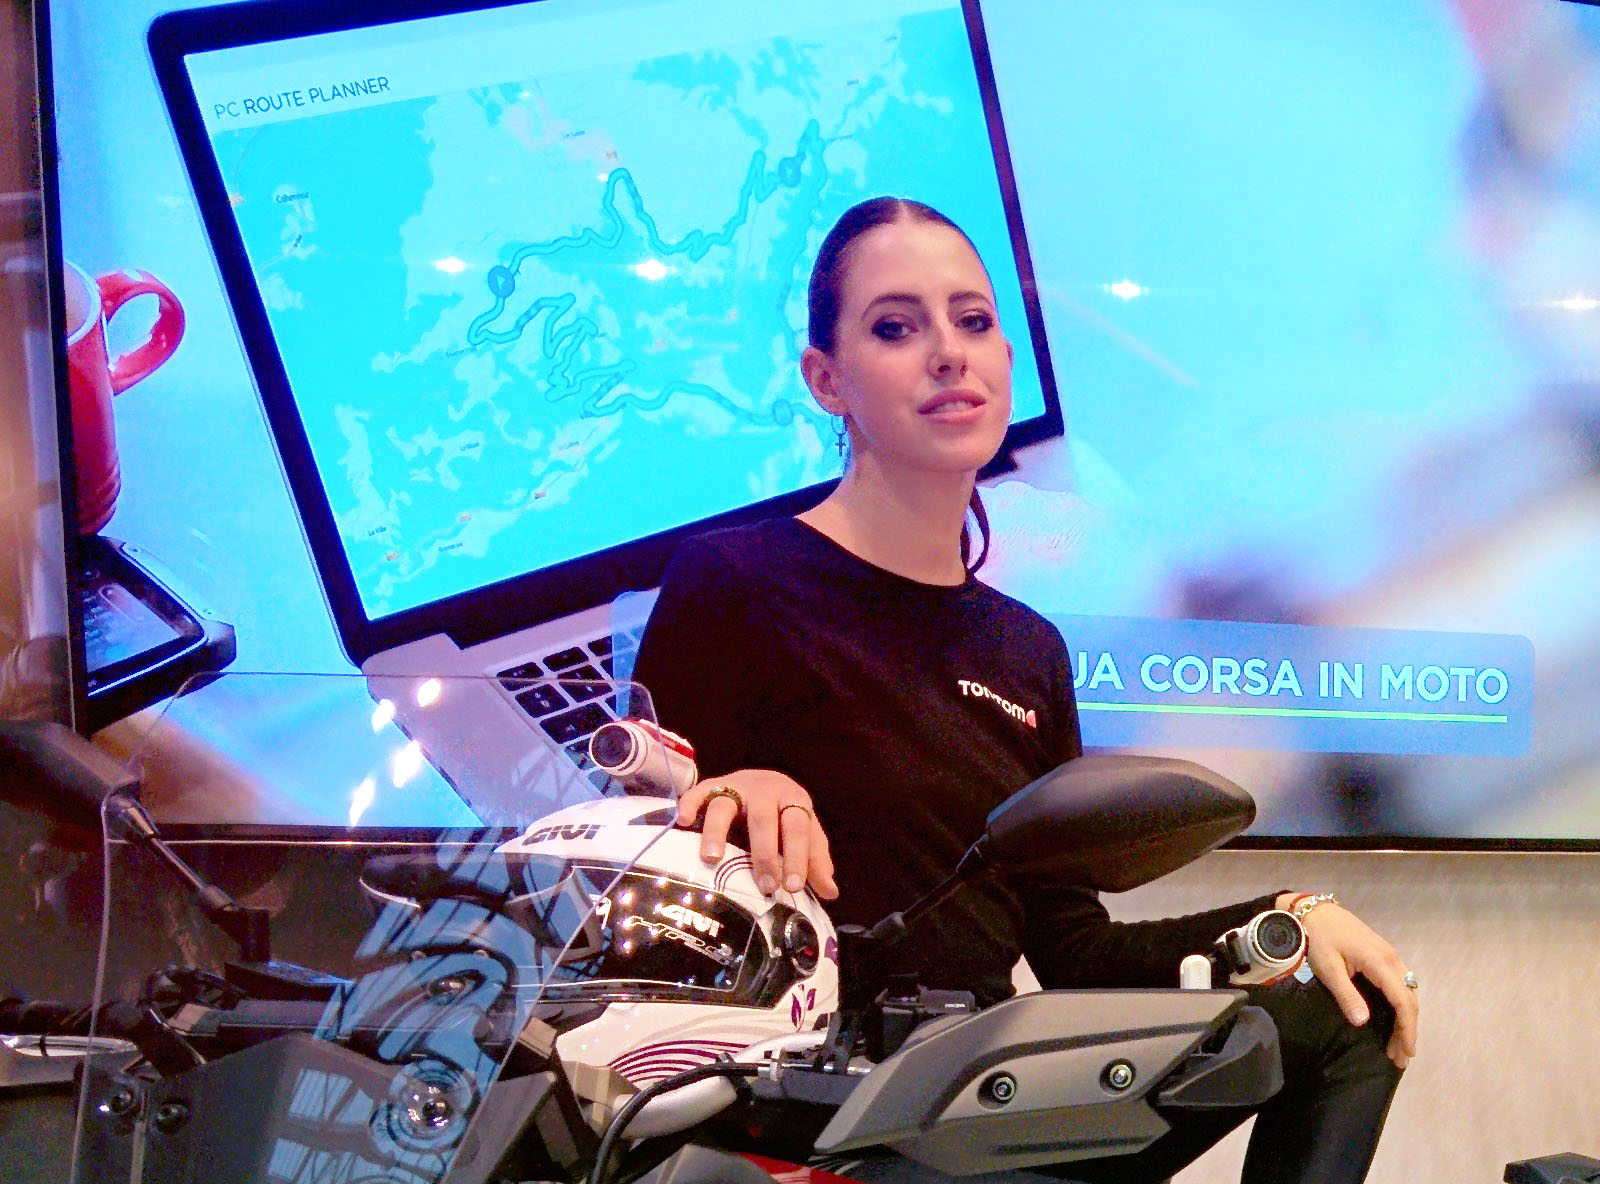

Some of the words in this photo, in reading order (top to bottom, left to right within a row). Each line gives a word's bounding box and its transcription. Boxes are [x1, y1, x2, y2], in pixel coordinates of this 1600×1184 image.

[214, 101, 241, 120] PC
[243, 90, 305, 115] ROUTE
[308, 76, 391, 104] PLANNER
[1140, 653, 1303, 698] CORSA
[1319, 660, 1364, 700] IN
[1380, 663, 1509, 705] MOTO
[521, 823, 602, 847] GIVI
[660, 904, 722, 938] GIVI
